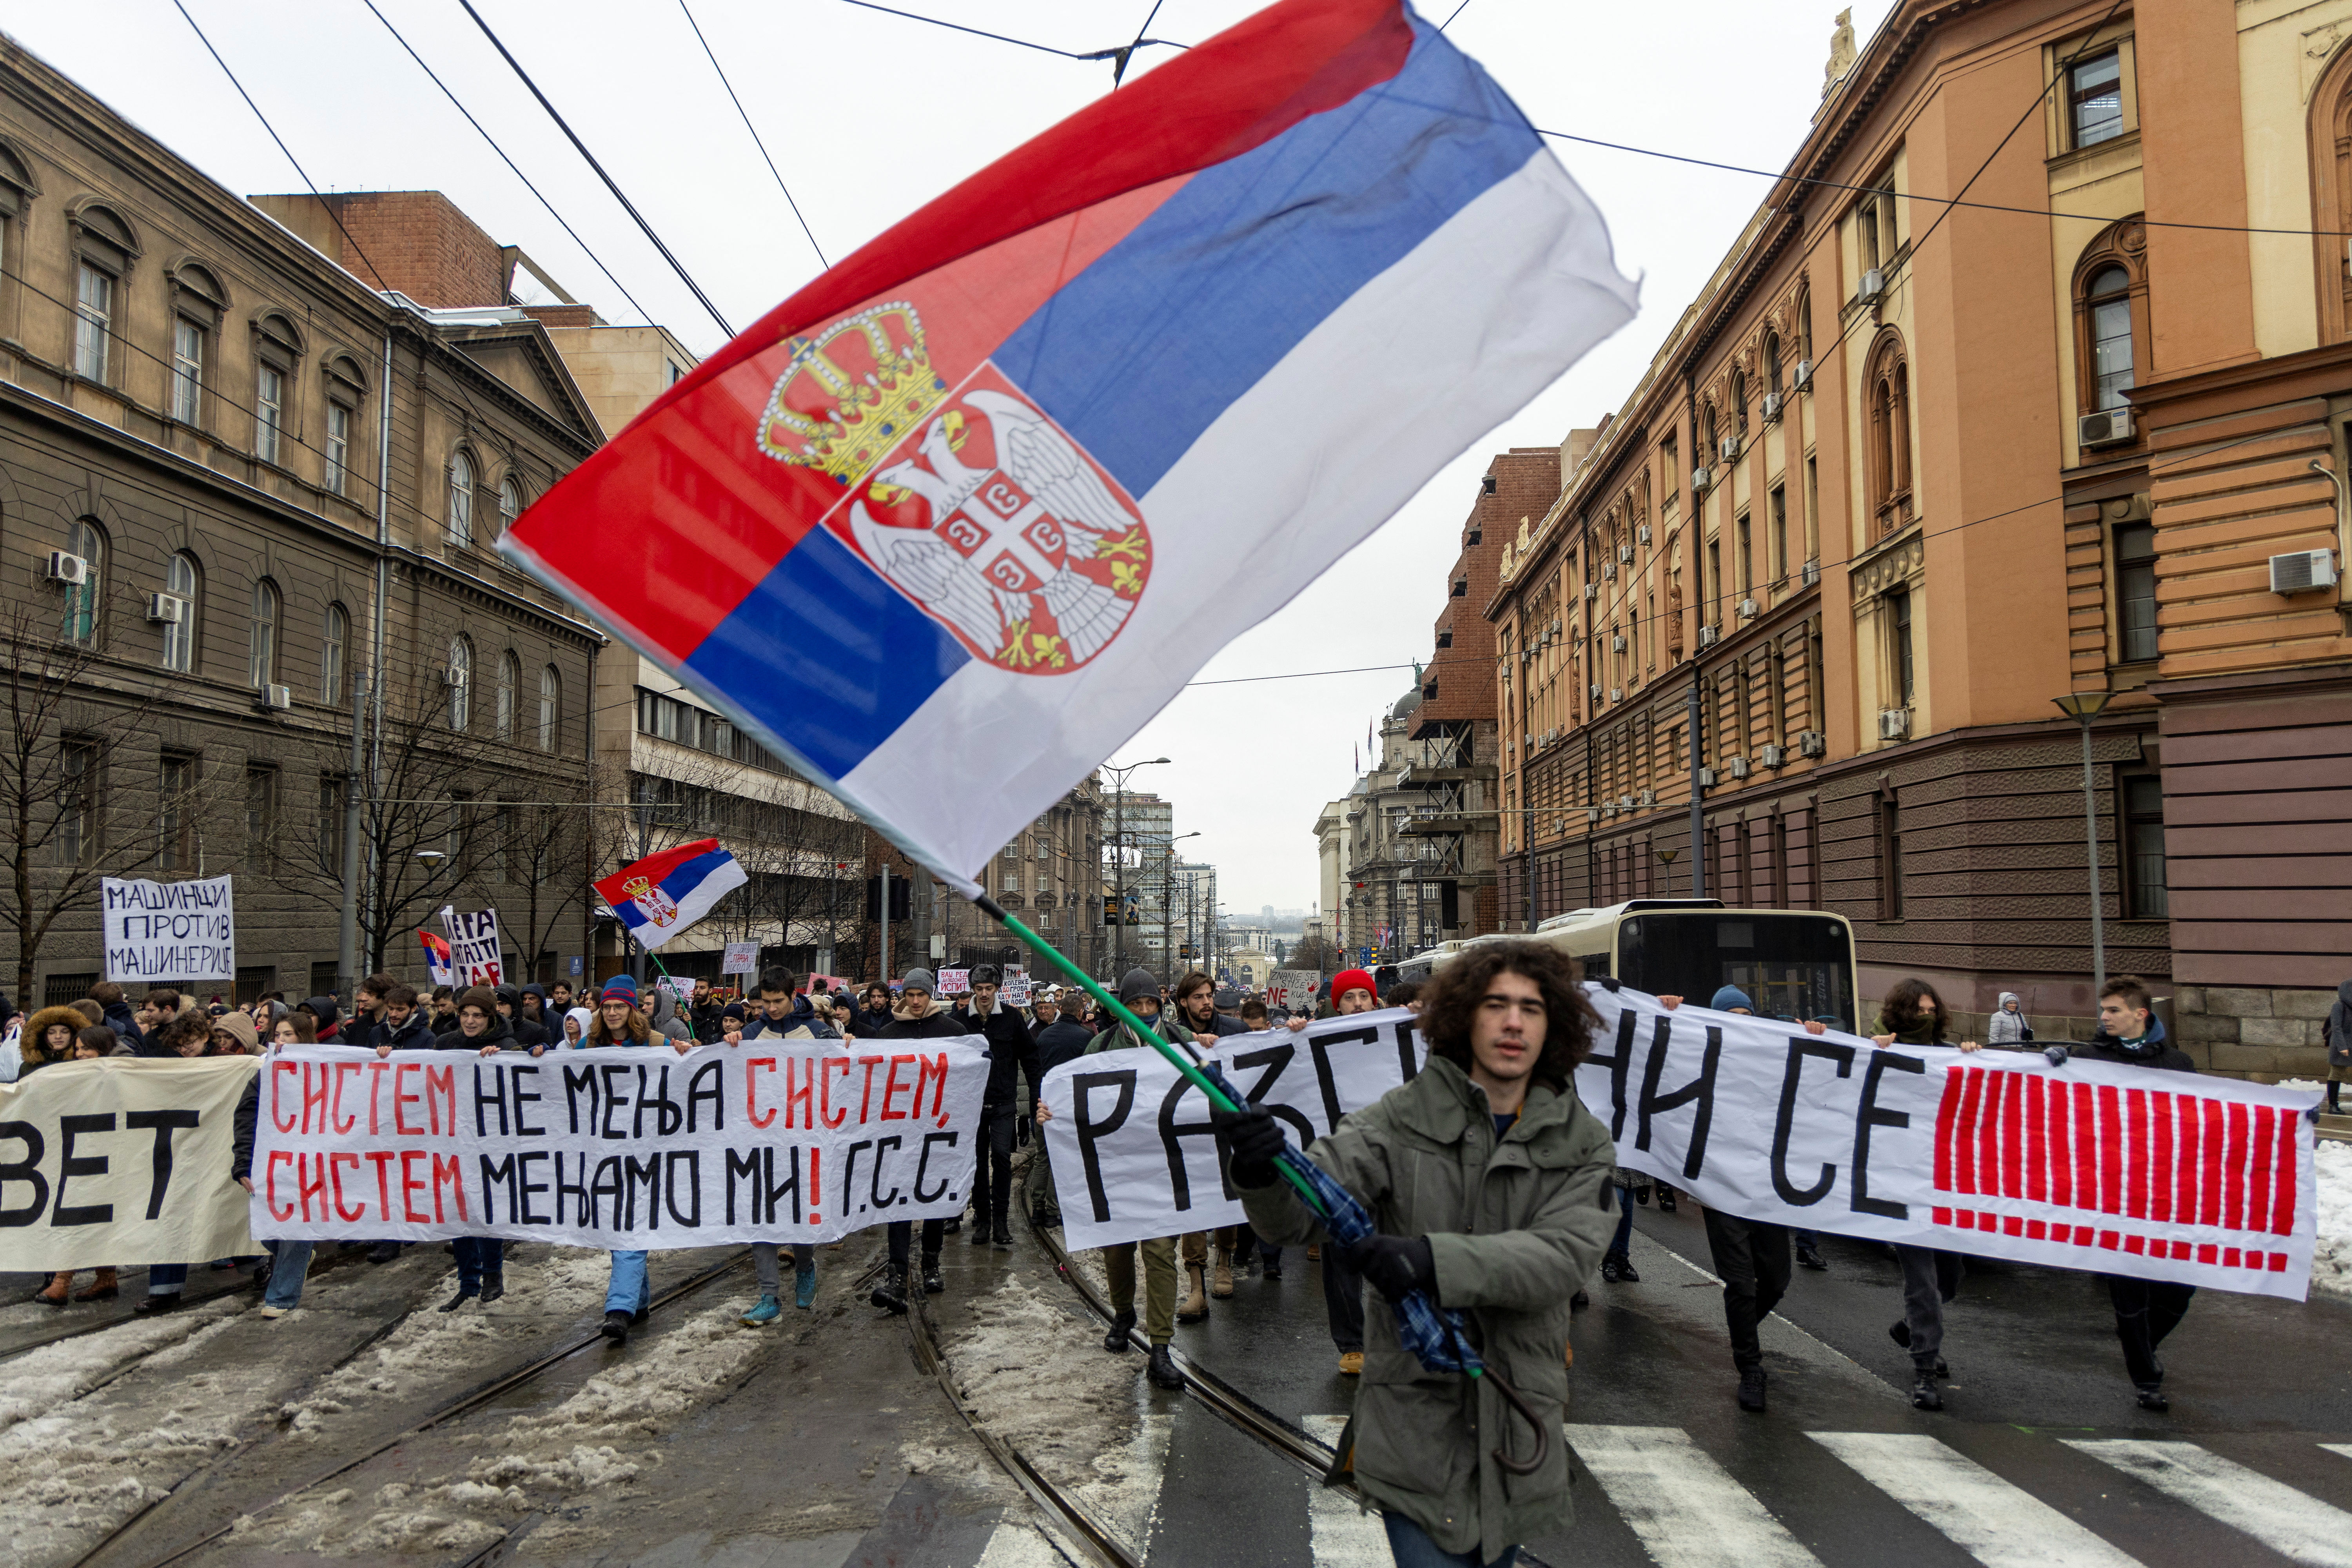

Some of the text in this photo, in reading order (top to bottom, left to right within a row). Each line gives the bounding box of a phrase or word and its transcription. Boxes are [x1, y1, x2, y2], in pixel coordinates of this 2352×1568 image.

[107, 884, 227, 909] МАШИНЦИ
[123, 914, 229, 940] ПРОТИВ
[110, 946, 231, 975] МАШИНЕРИЈЕ
[941, 982, 967, 991] ИСПИТ
[1004, 978, 1029, 987] КОЛЕВКЕ
[1281, 980, 1306, 989] STIČE
[1305, 972, 1316, 981] SE
[1266, 987, 1288, 1005] NE
[272, 1052, 951, 1140] СИСТЕМ НЕ МЕЊА СИСТЕМ,
[267, 1151, 468, 1223] СИСТЕМ
[479, 1150, 701, 1232] МЕЊАМО
[726, 1145, 821, 1226] МИ!
